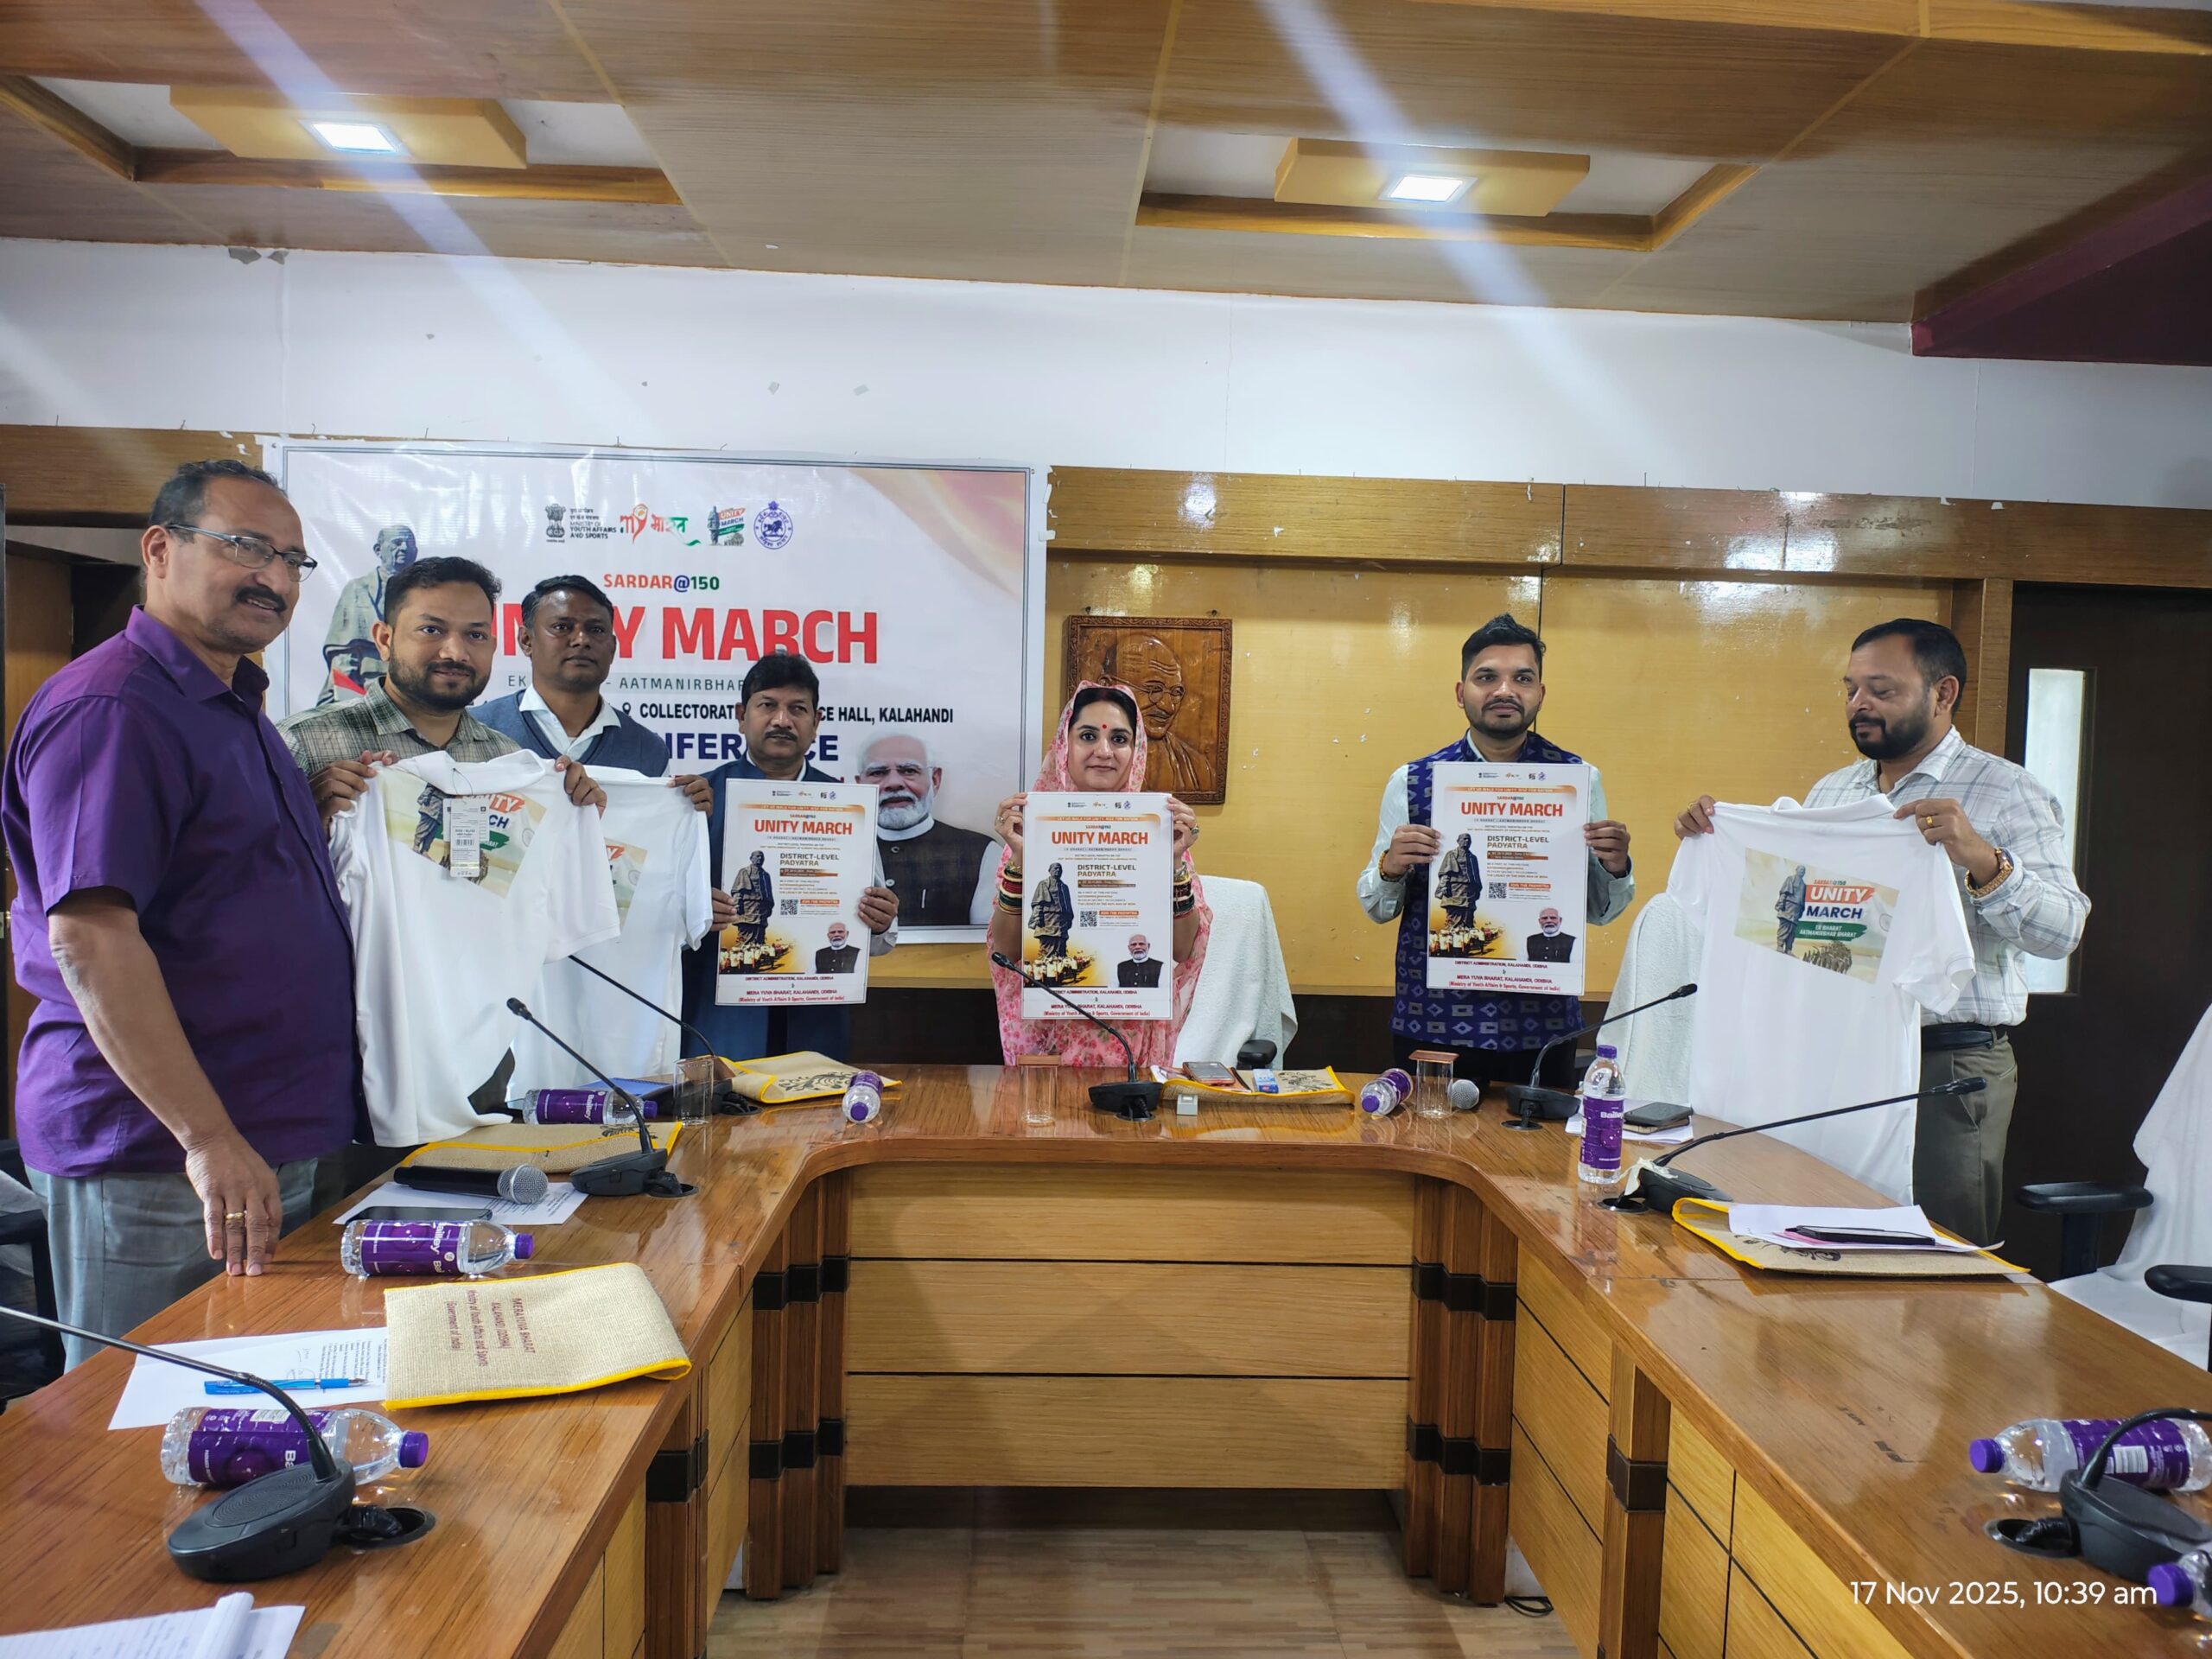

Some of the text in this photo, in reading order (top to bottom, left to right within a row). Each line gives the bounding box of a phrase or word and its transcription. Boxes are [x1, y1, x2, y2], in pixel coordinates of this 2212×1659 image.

[721, 517, 744, 526] MARCH
[603, 573, 720, 593] SARDAR@150
[662, 607, 878, 664] MARCH
[508, 676, 526, 688] EK
[639, 702, 735, 720] COLLECTORAT
[838, 706, 874, 725] HALL,
[879, 707, 954, 723] KALAHANDI
[1460, 802, 1562, 817] UNITY MARCH
[754, 819, 852, 835] UNITY MARCH
[1052, 831, 1147, 845] UNITY MARCH
[1811, 887, 1868, 902] UNITY
[1806, 906, 1863, 919] MARCH
[519, 1332, 536, 1354] BHARAT
